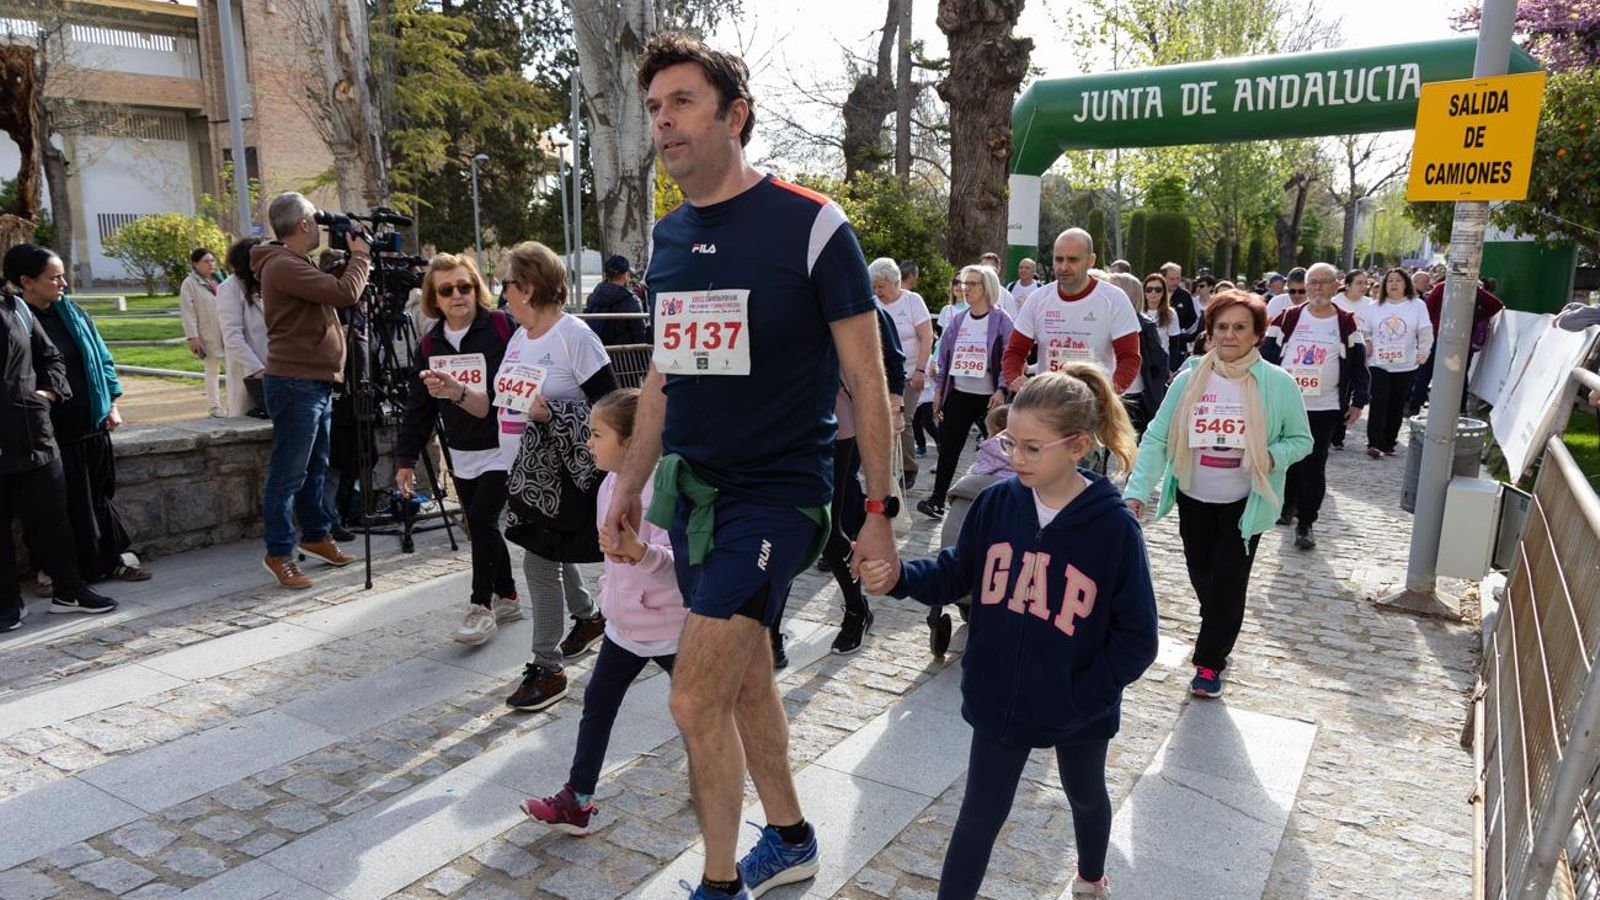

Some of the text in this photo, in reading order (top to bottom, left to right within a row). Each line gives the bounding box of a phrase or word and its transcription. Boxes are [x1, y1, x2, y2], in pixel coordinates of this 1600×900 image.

[1073, 85, 1163, 122] JUNTA
[1180, 81, 1218, 116] DE
[1448, 90, 1509, 117] SALIDA
[1463, 125, 1486, 148] DE
[1424, 161, 1513, 185] CAMIONES
[691, 244, 717, 254] FILA
[662, 321, 742, 350] 5137
[954, 360, 984, 371] 5396
[498, 376, 538, 399] 5447
[1194, 418, 1246, 435] 5467
[757, 538, 773, 571] RUN
[980, 541, 1098, 637] GAP
